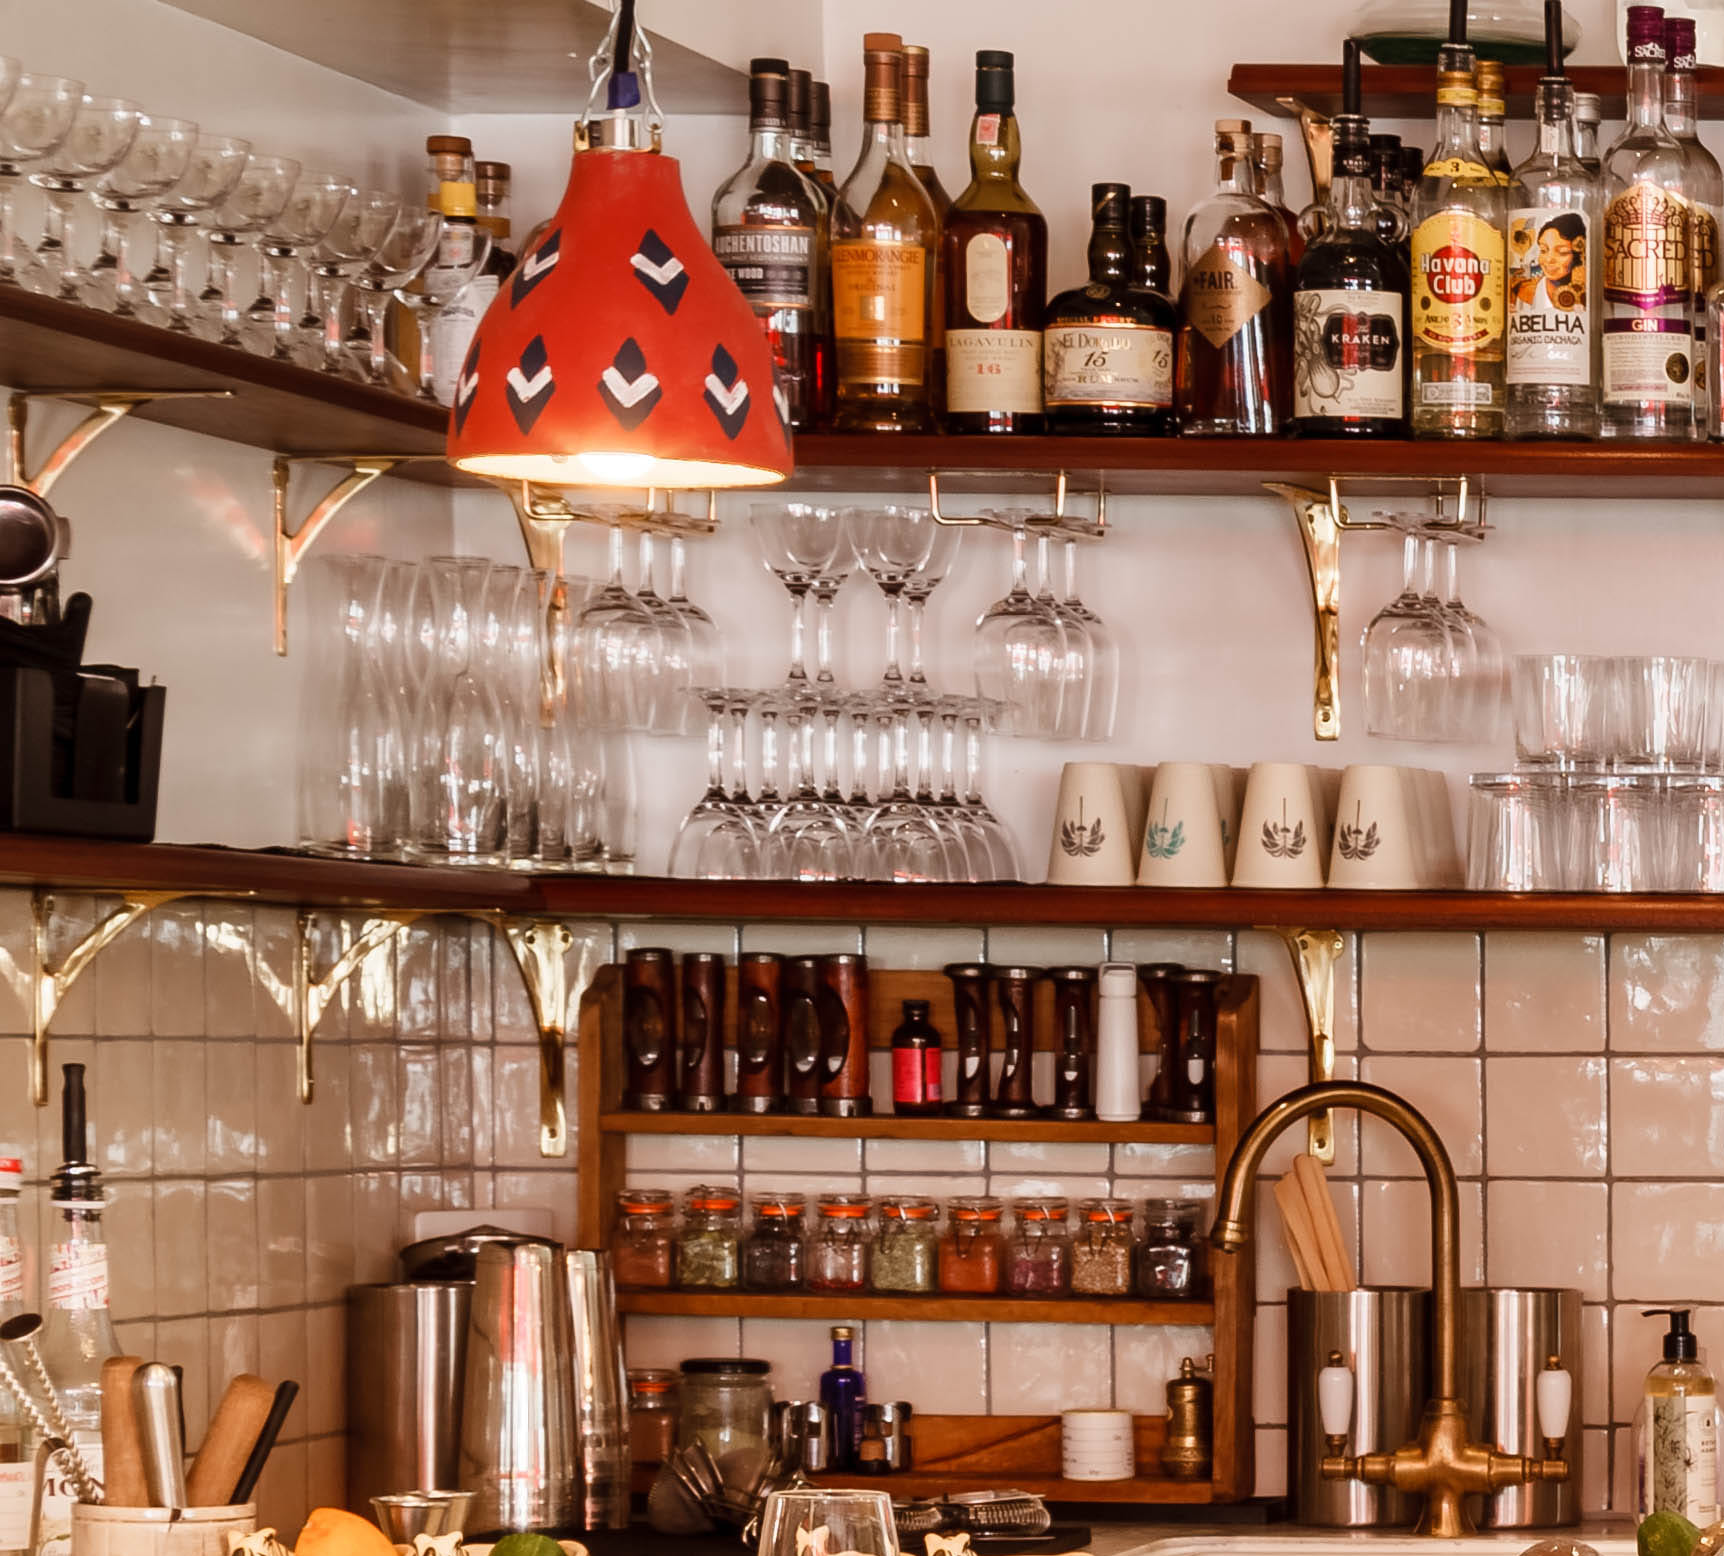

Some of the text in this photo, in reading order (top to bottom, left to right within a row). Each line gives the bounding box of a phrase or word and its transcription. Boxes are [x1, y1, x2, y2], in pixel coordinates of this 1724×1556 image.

[1605, 239, 1688, 260] SACRED
[1420, 253, 1491, 275] Havana
[1433, 275, 1476, 295] Club
[1509, 313, 1585, 335] ABELHA
[1631, 319, 1659, 332] GIN
[948, 336, 1034, 348] LAGAVULIN
[1330, 333, 1391, 346] KRAKEN
[1082, 351, 1109, 368] 15
[1151, 349, 1169, 369] 15
